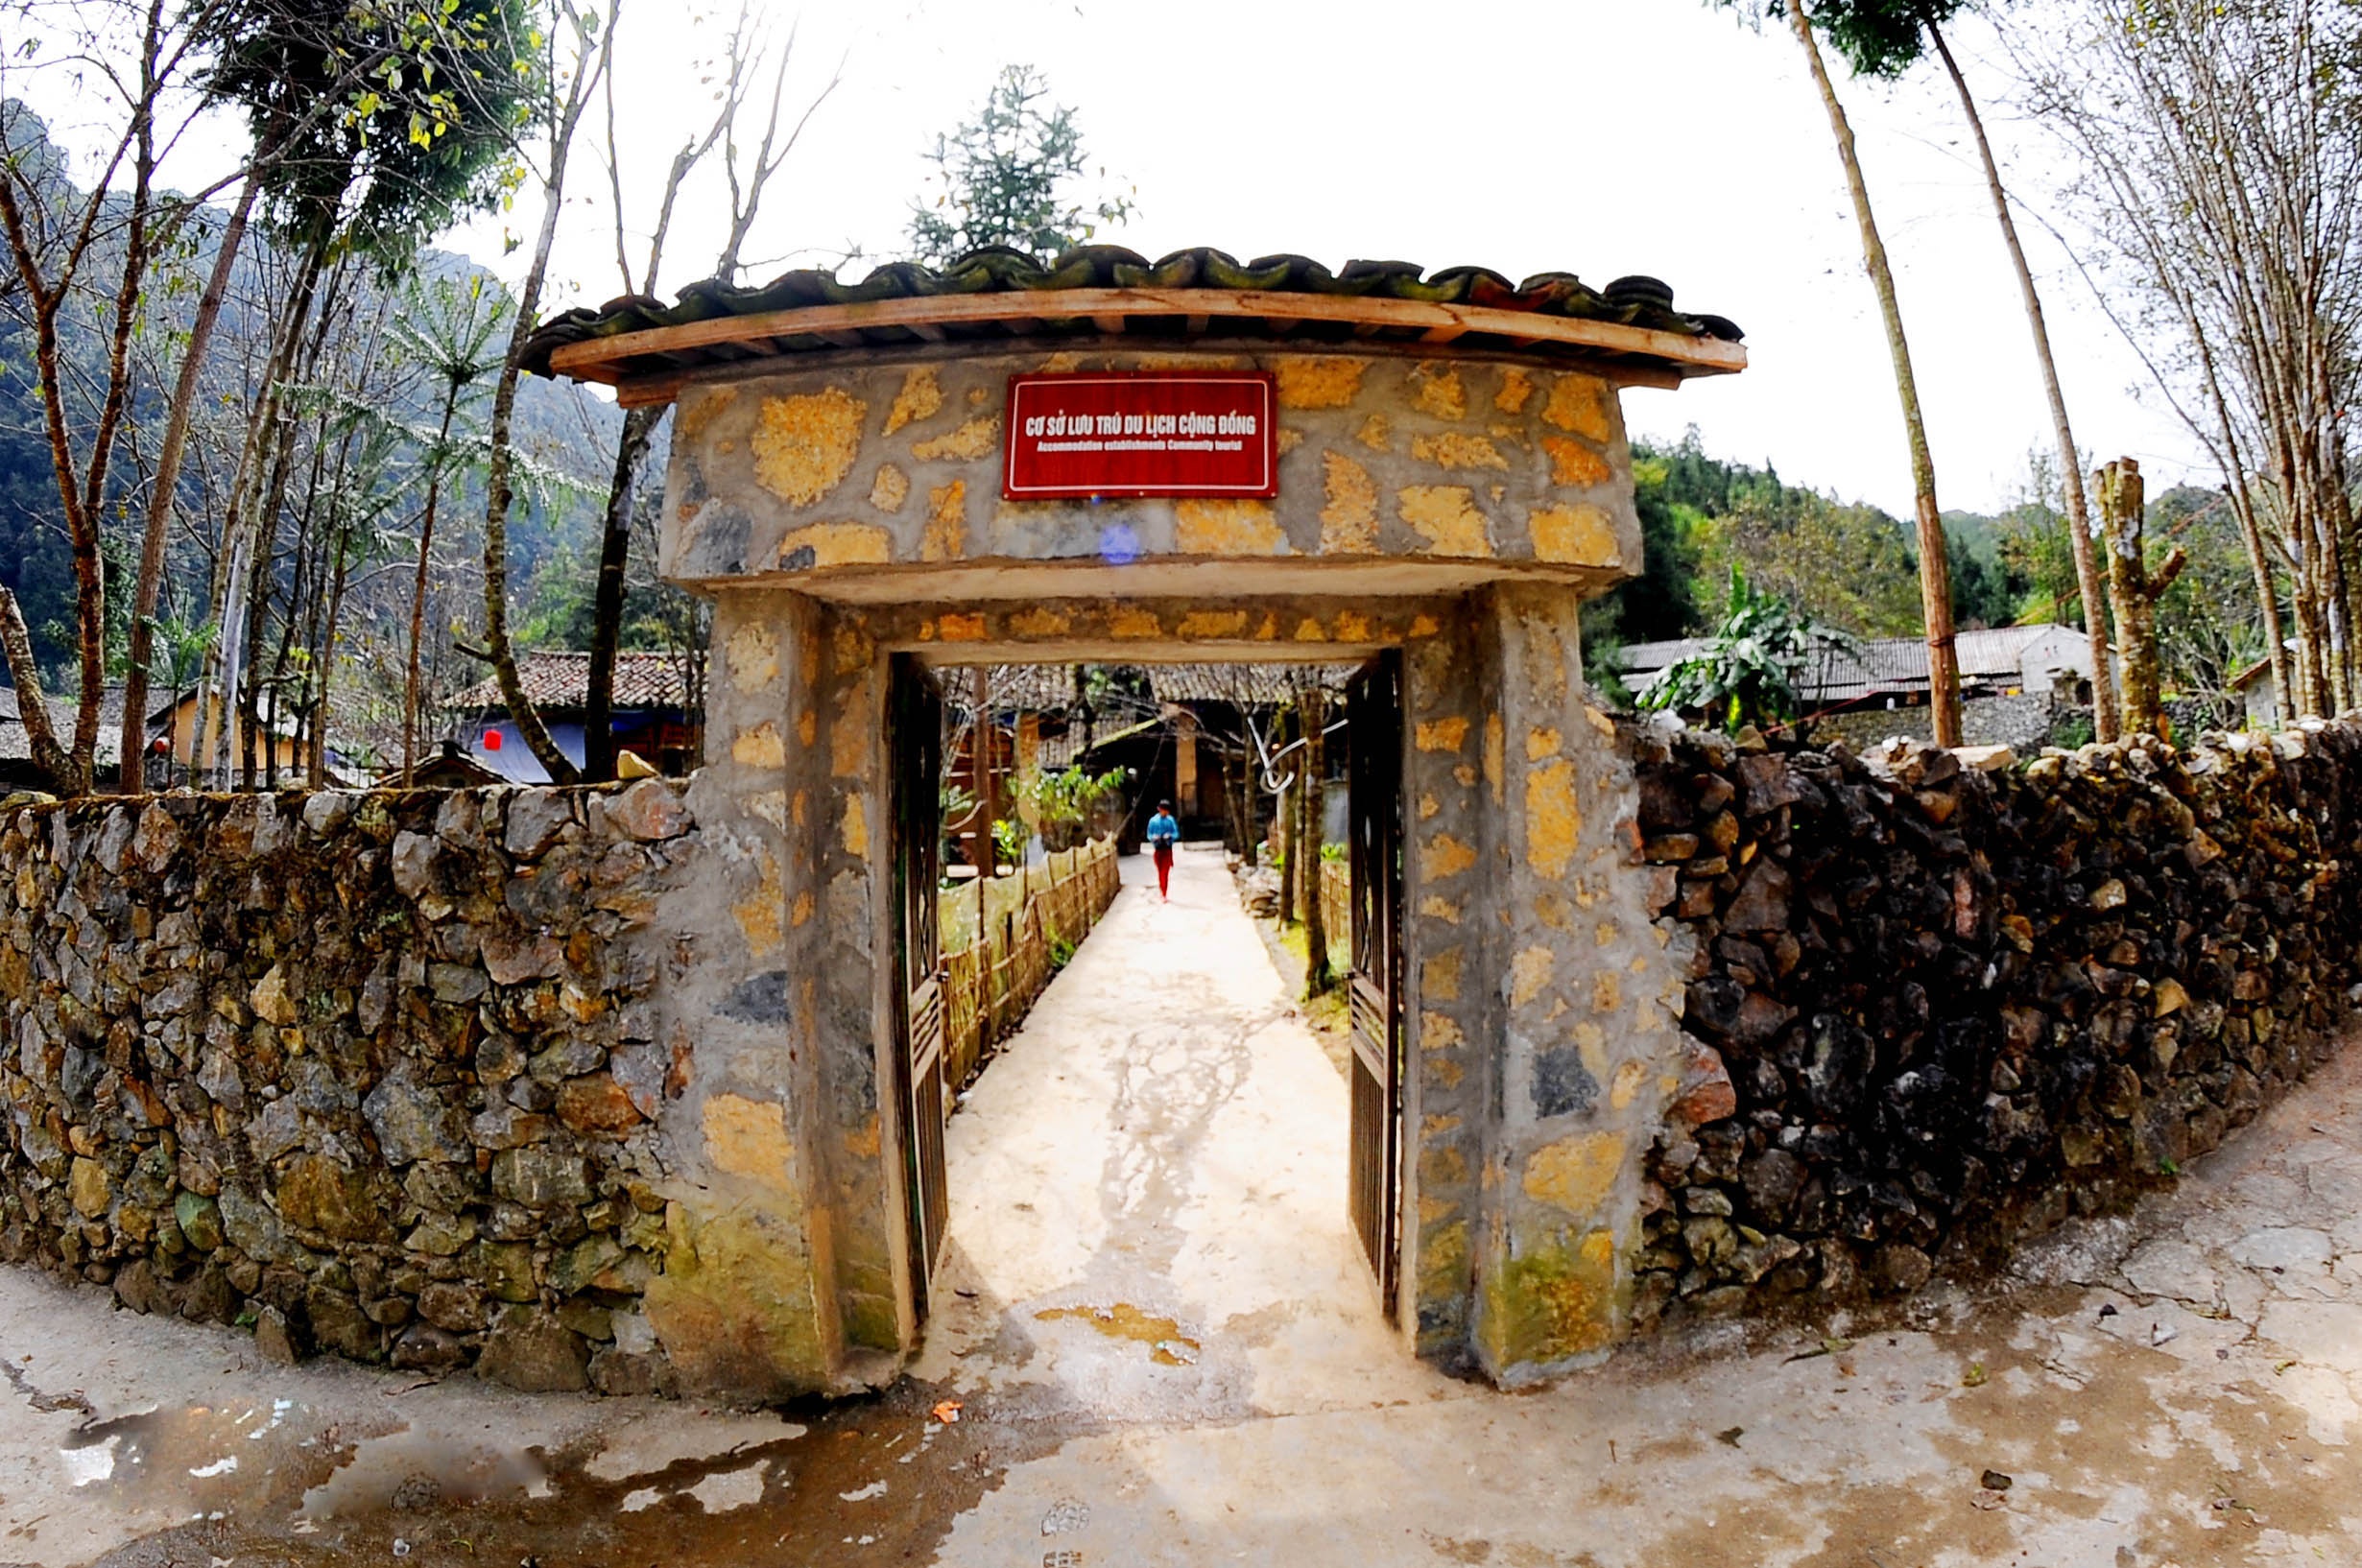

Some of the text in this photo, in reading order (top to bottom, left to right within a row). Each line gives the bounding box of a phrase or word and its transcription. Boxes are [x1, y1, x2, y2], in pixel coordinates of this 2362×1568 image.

[1026, 416, 1045, 437] CƠ
[1046, 409, 1066, 437] SỞ
[1124, 415, 1143, 435] DU
[1145, 415, 1177, 439] LỊCH
[1179, 411, 1216, 439] CỘNG
[1167, 439, 1214, 452] Community
